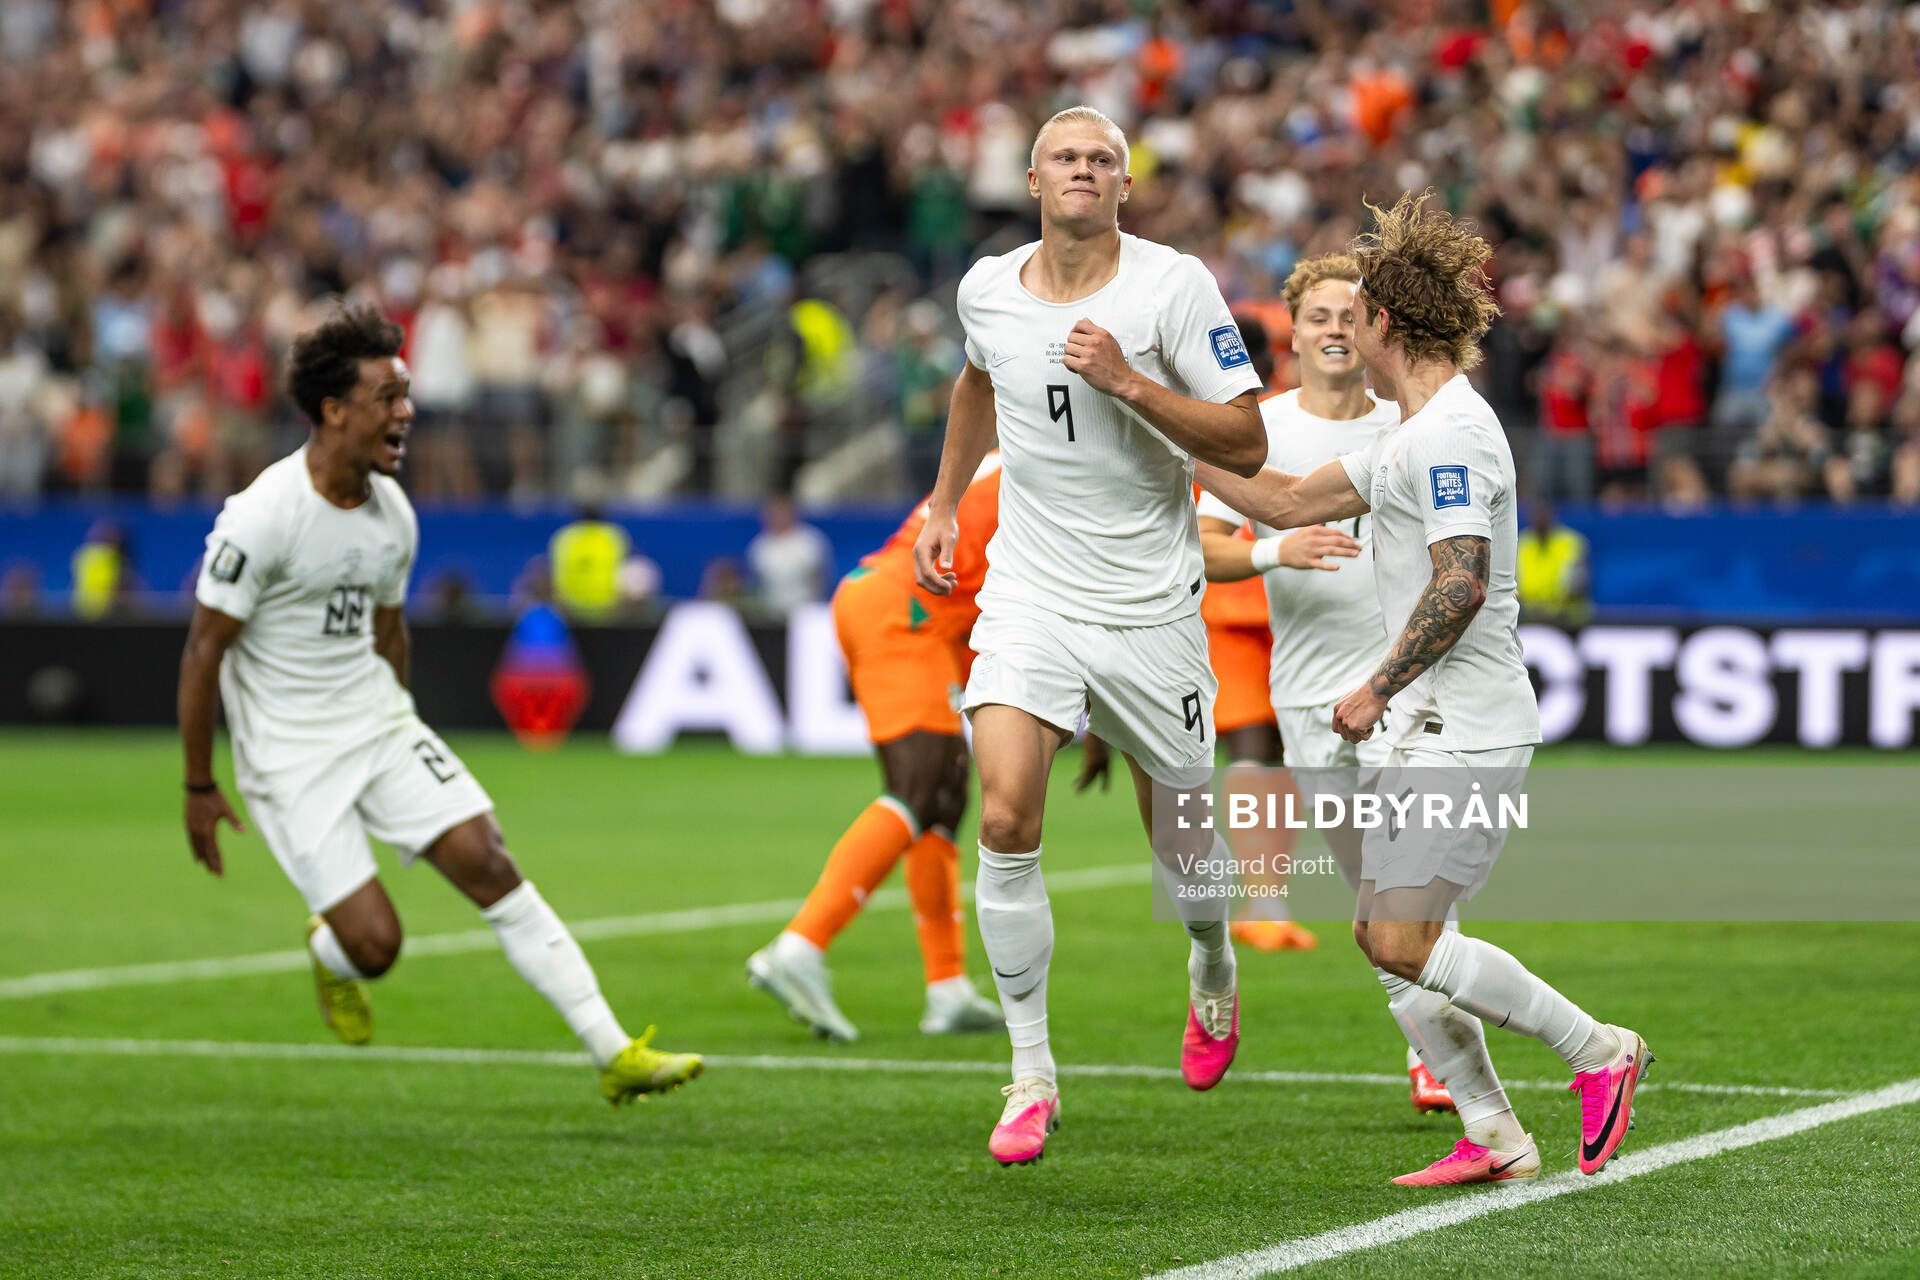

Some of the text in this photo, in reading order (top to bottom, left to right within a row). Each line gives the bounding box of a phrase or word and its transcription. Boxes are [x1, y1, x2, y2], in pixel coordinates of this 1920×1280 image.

[1217, 337, 1239, 351] UNITES
[1046, 384, 1076, 442] 9
[1436, 472, 1461, 480] FOOTBALL
[1437, 478, 1463, 489] UNITES
[322, 584, 371, 635] 22
[1181, 688, 1205, 744] 9
